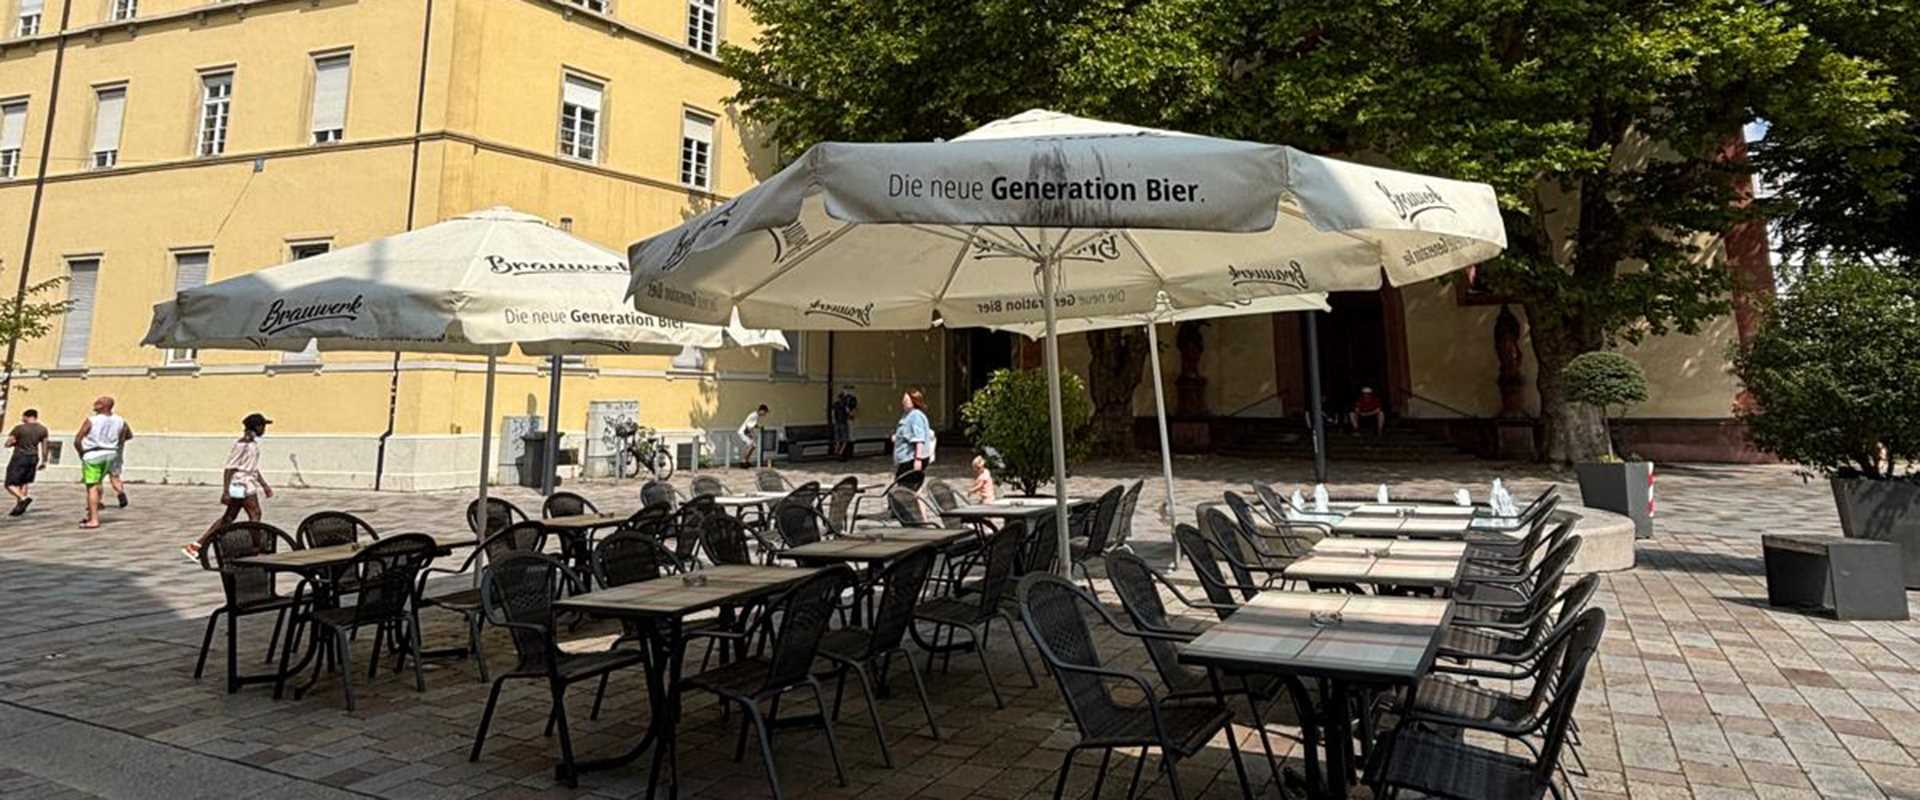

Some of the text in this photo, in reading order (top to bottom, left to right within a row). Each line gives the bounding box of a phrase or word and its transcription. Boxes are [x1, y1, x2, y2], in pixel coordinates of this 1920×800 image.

[888, 173, 1206, 202] Die neue Generation Bier.
[258, 294, 363, 335] Brauwerk
[504, 307, 529, 324] Die
[531, 310, 567, 325] neue
[570, 308, 655, 328] Generation
